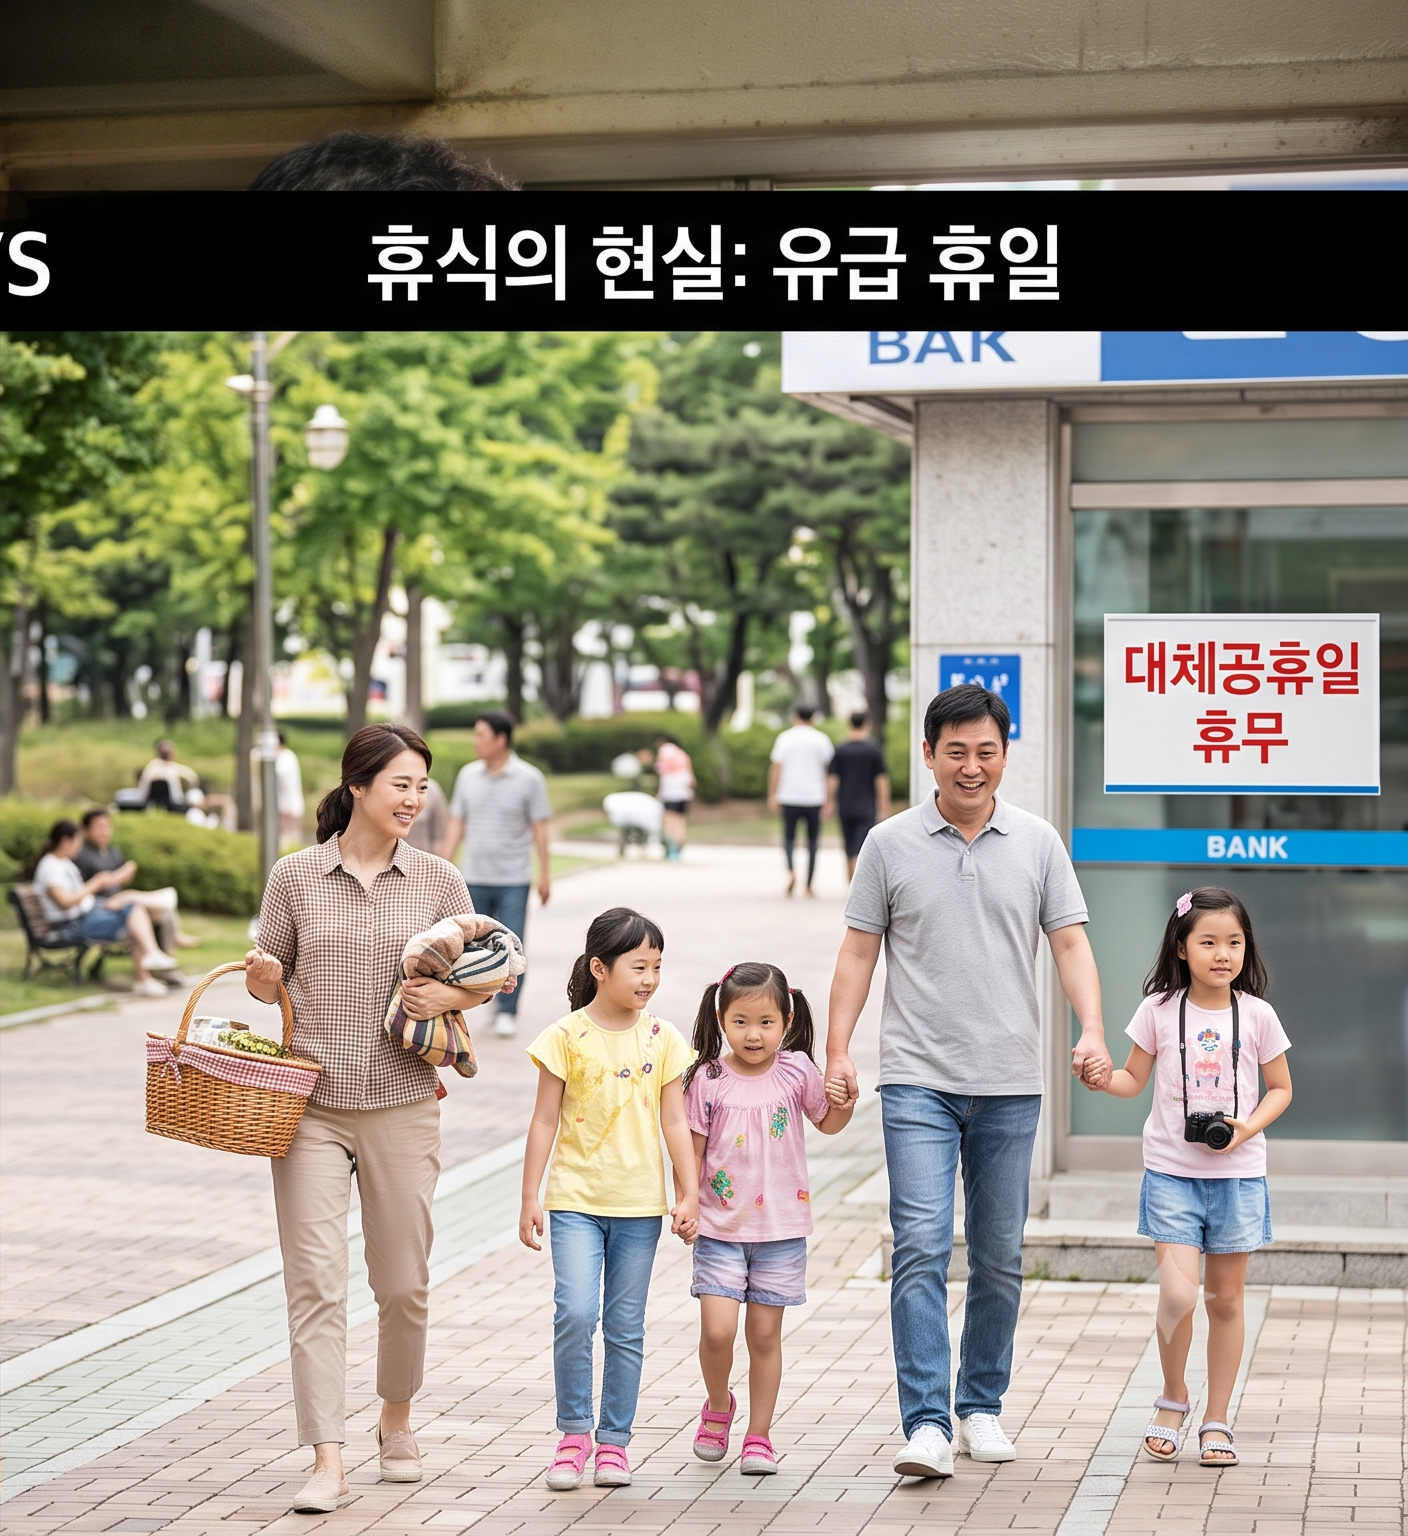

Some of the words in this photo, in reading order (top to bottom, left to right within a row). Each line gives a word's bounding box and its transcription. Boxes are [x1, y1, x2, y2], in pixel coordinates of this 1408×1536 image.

[1125, 641, 1360, 696] 대체공휴일
[1193, 709, 1289, 764] 휴무
[1206, 835, 1289, 859] BANK
